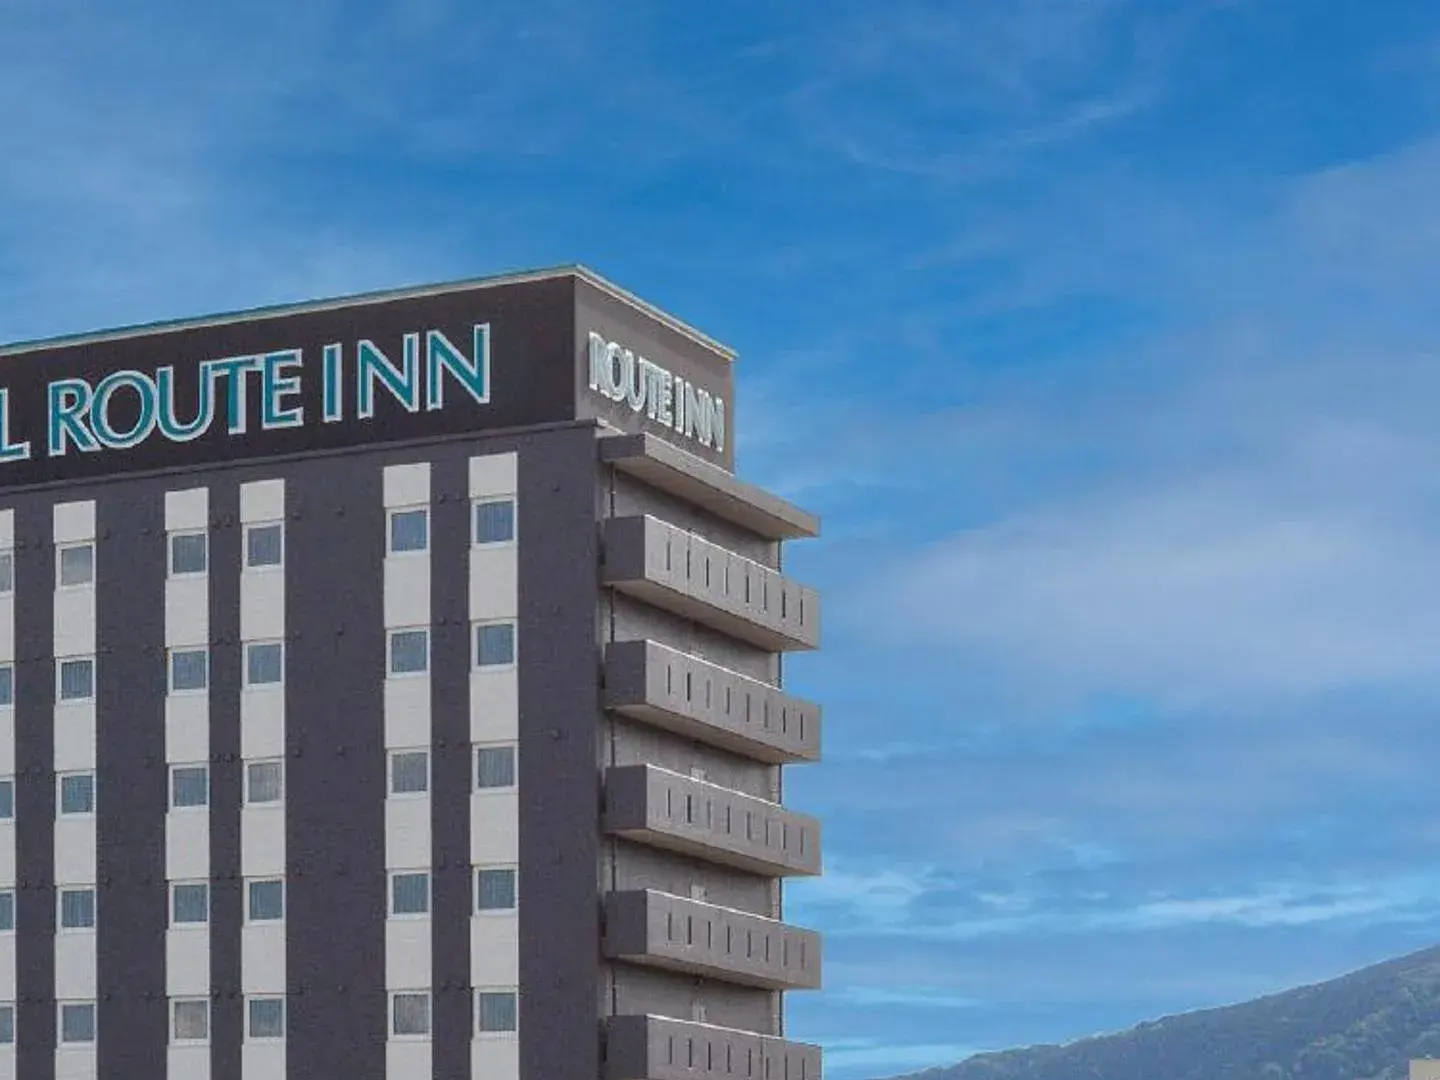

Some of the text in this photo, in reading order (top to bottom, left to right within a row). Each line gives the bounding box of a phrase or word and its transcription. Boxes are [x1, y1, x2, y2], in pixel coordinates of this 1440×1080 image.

[48, 348, 304, 456] ROUTE
[323, 322, 490, 423] INN
[589, 331, 725, 453] ROUTE INN
